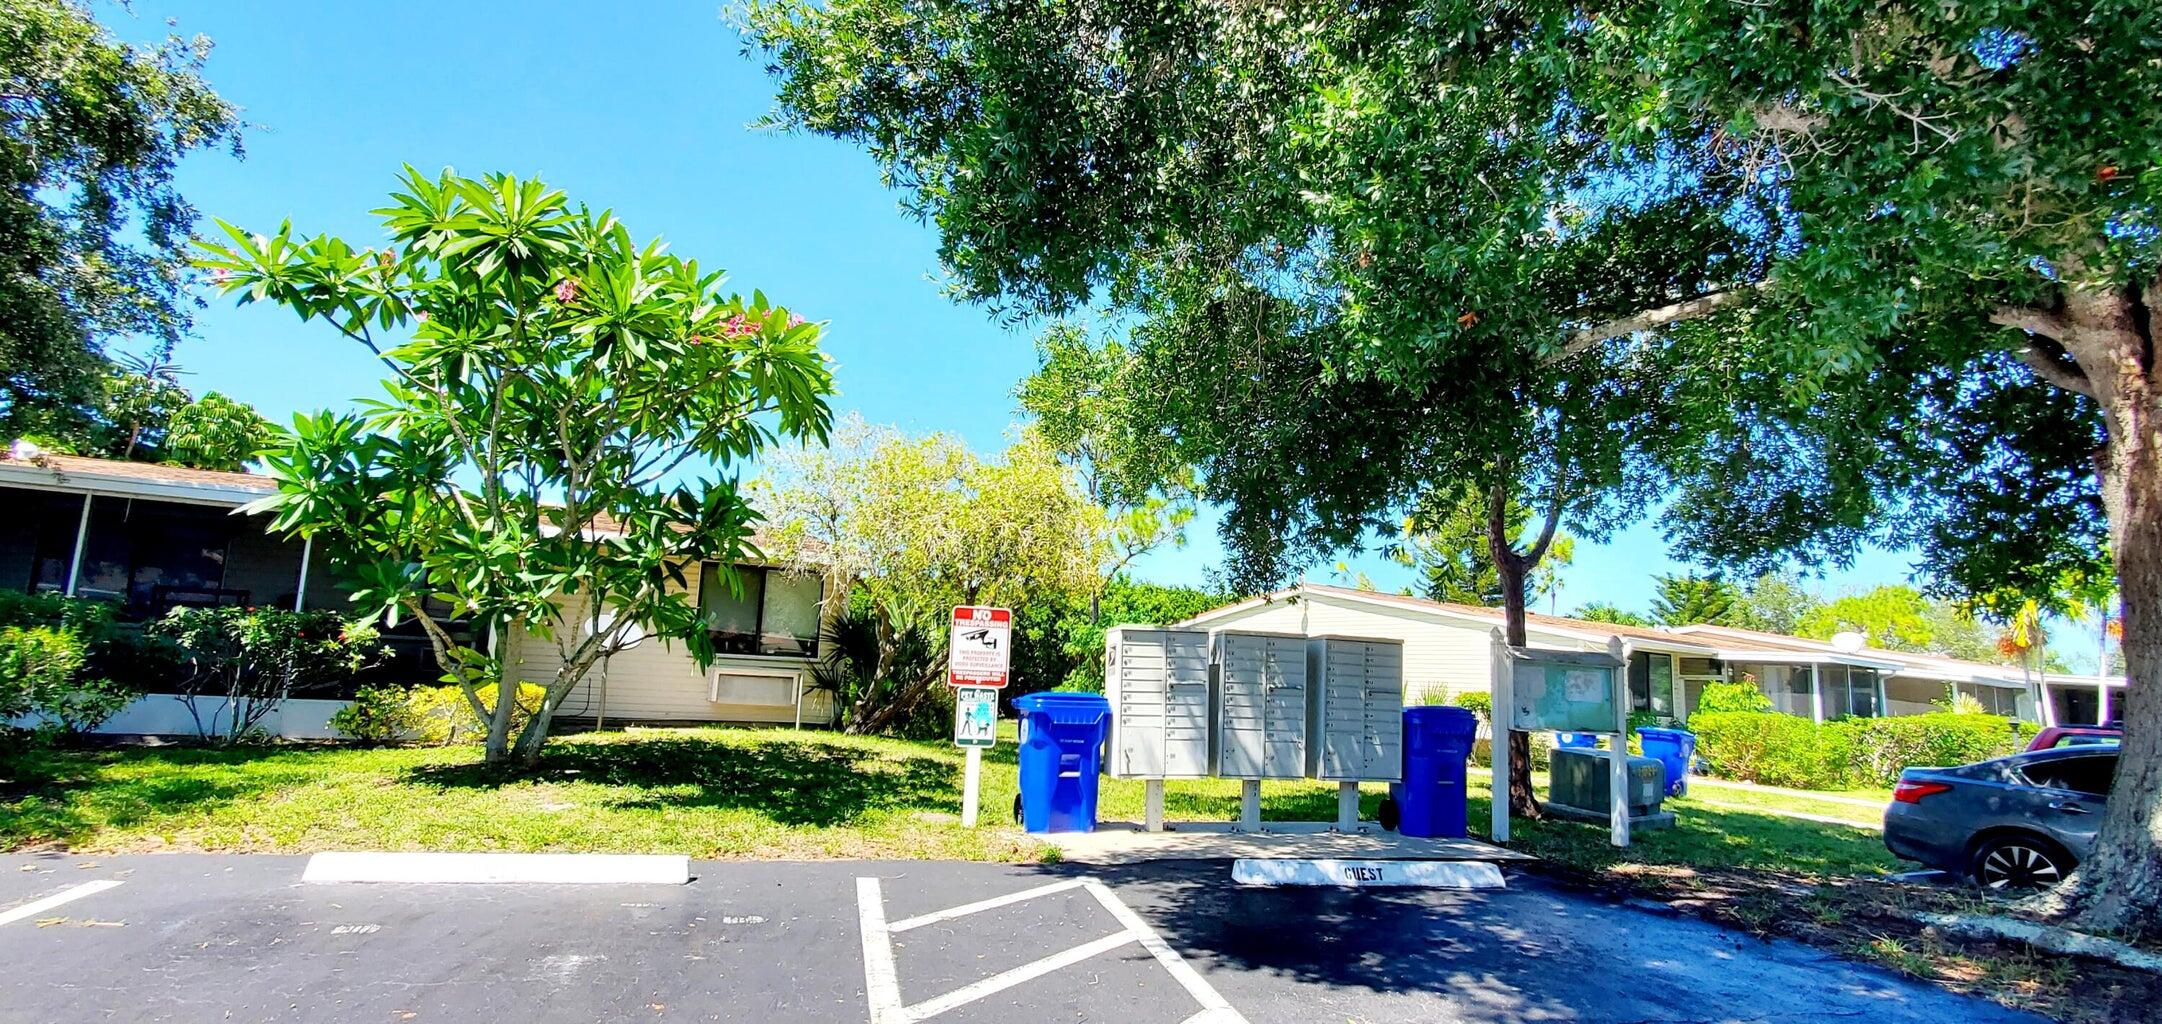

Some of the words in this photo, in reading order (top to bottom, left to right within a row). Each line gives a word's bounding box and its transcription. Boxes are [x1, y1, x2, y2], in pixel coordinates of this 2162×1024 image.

[973, 609, 992, 621] NO
[954, 619, 1009, 628] TRESPASSING
[1344, 867, 1383, 881] GUEST
